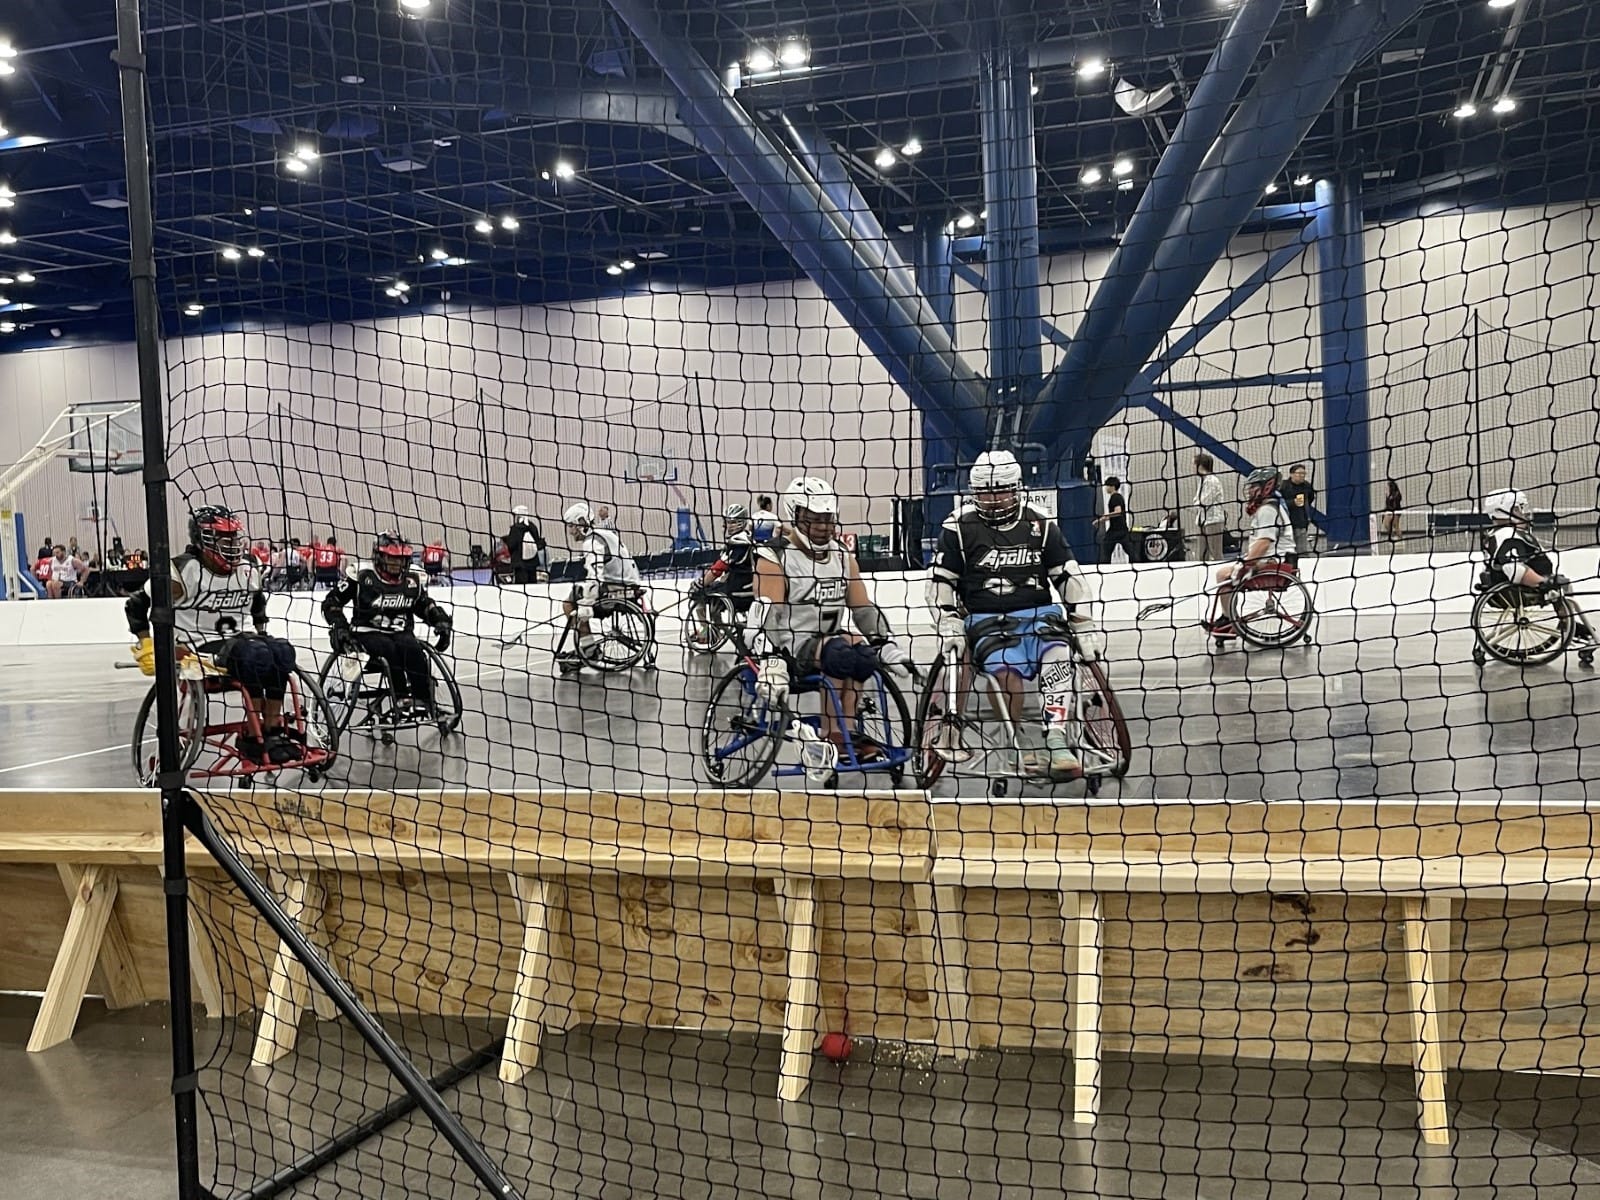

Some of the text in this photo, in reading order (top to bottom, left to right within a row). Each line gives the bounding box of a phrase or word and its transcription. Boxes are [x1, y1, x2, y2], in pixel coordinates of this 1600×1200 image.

[320, 550, 334, 563] 33
[978, 548, 1042, 570] Apollos
[198, 590, 250, 611] Apollos
[821, 608, 839, 633] 7
[1046, 694, 1065, 706] 34
